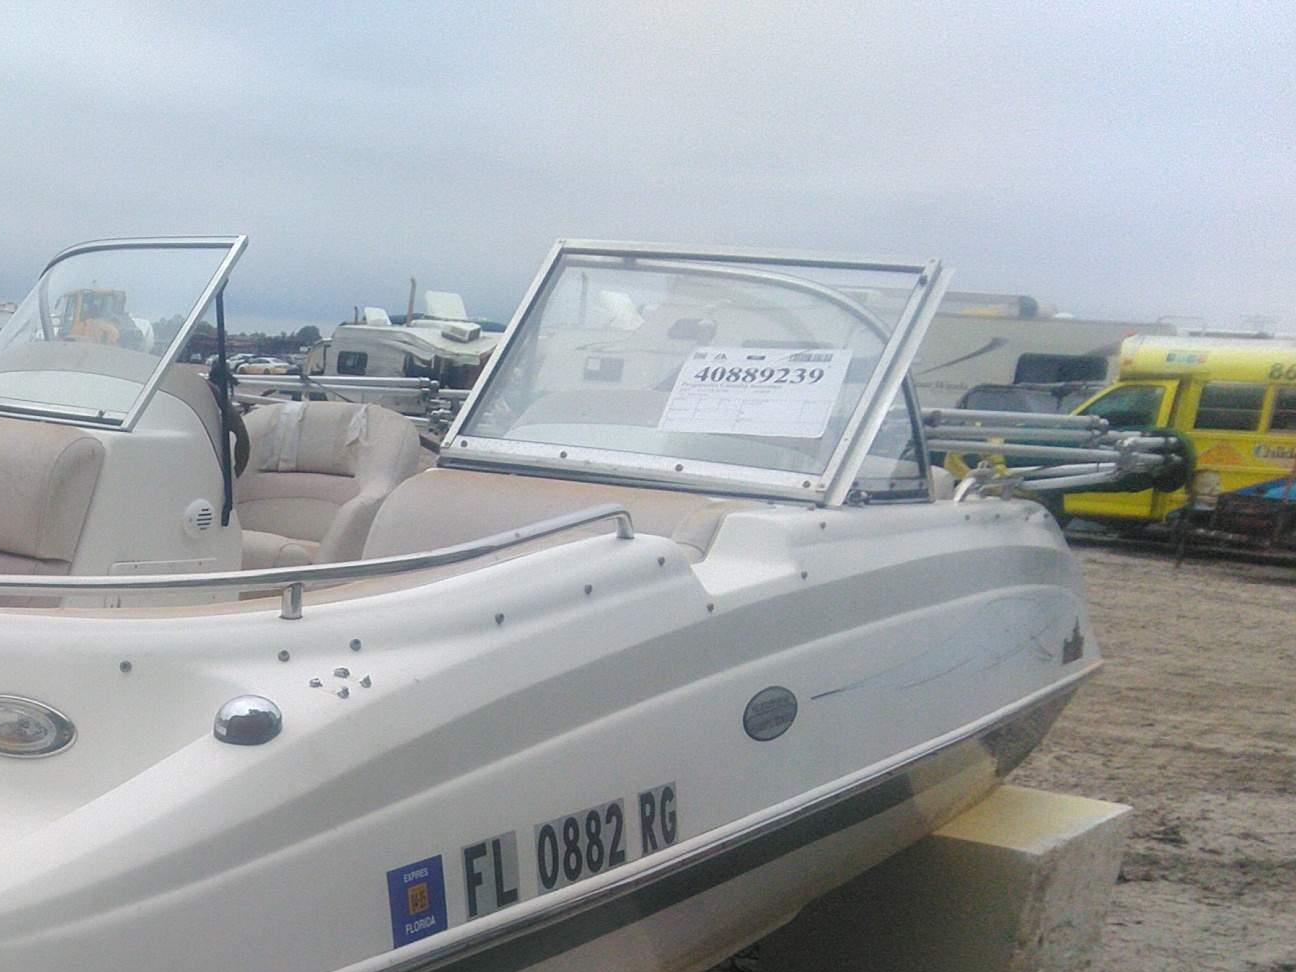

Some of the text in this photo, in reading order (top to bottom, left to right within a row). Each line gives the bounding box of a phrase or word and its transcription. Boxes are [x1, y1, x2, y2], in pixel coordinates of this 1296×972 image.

[693, 365, 825, 385] 40889239
[464, 786, 677, 917] FL 0882 RG
[406, 915, 436, 935] FLORIDA
